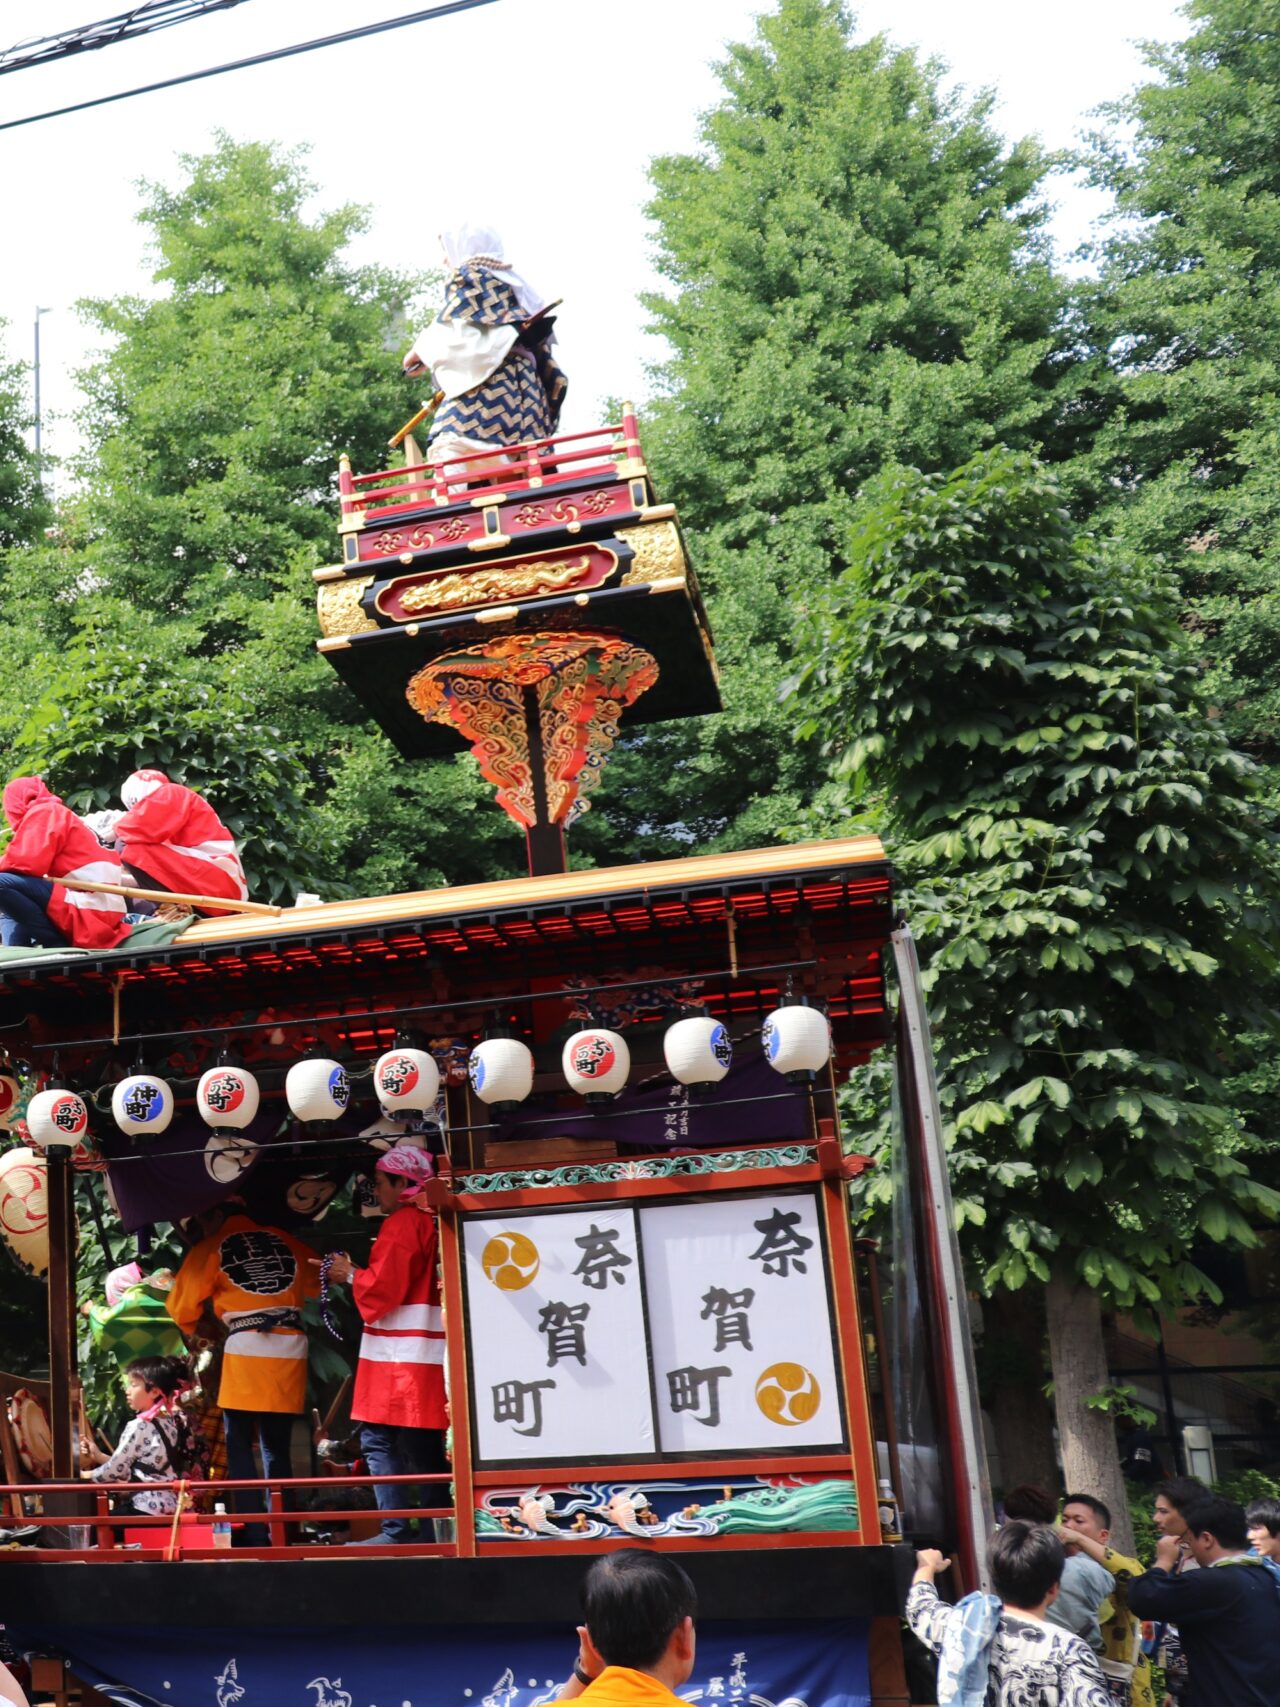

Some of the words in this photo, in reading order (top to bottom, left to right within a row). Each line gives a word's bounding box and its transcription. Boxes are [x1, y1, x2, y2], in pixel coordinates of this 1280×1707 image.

[125, 1085, 158, 1120] 仲町
[490, 1223, 633, 1438] 奈賀町
[665, 1207, 814, 1428] 奈賀町
[728, 1651, 749, 1707] 平成二
